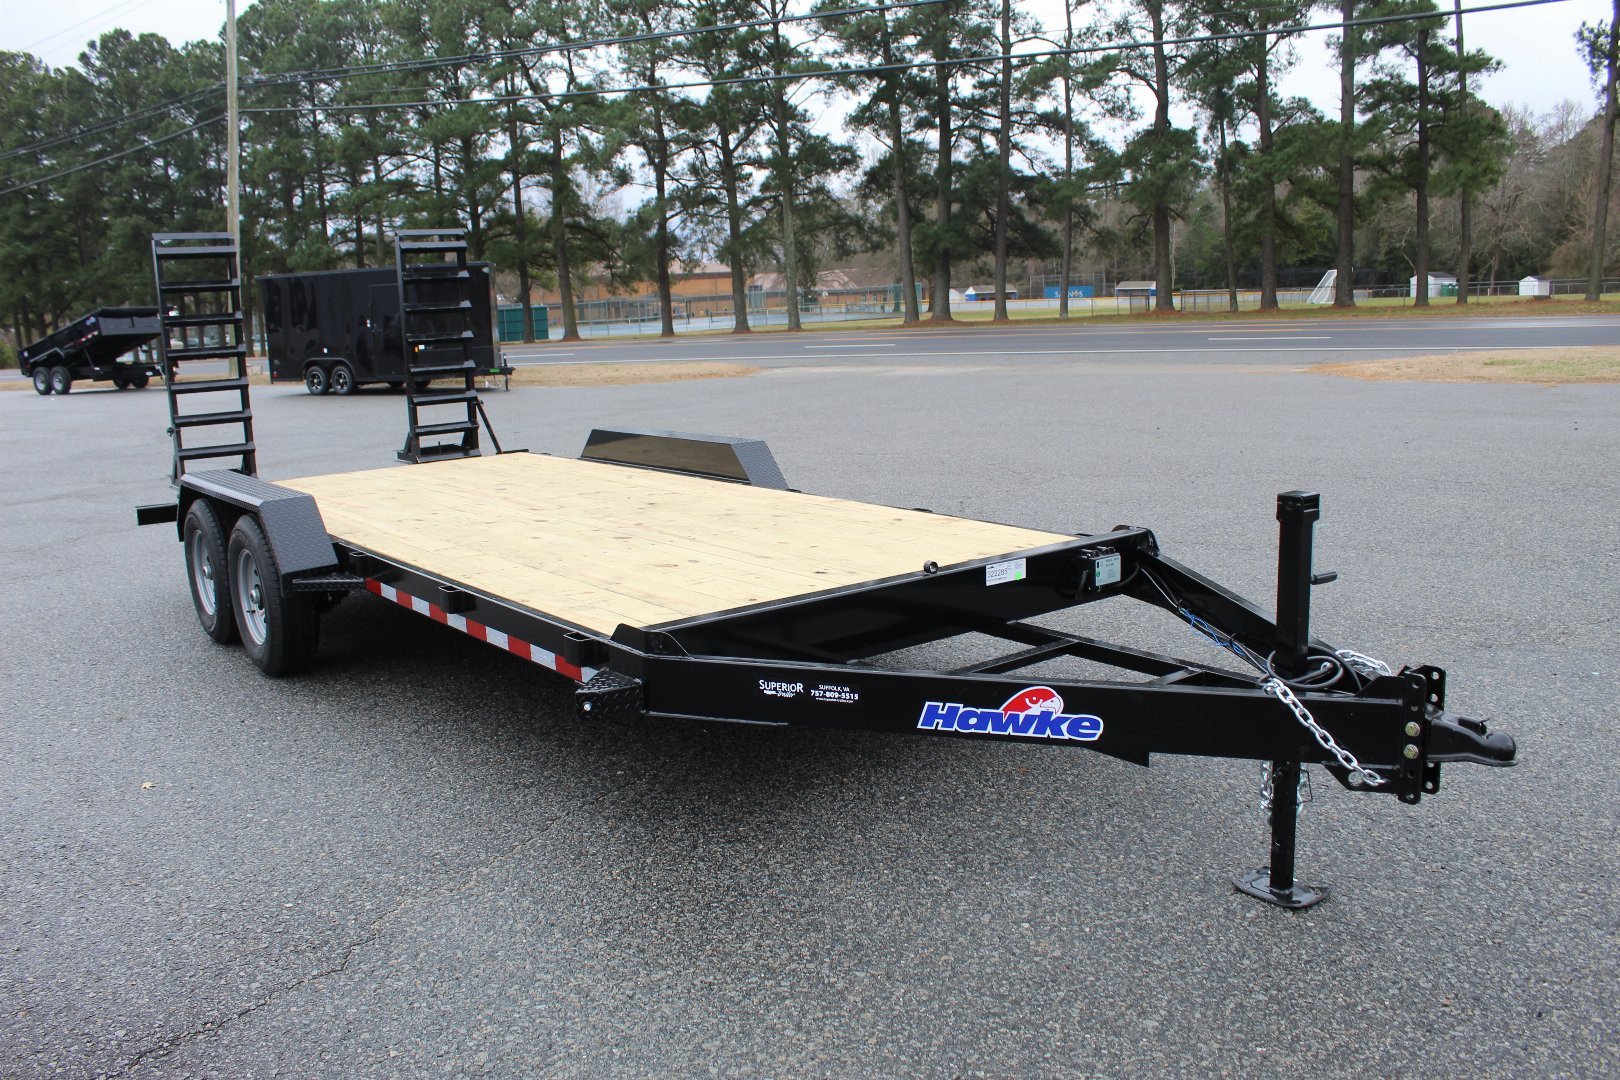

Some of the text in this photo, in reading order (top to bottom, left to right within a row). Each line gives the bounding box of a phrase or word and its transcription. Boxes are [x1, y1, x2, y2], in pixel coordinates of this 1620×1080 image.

[759, 679, 804, 693] SUPERIOR
[818, 684, 843, 692] SUFFOLK,
[810, 689, 859, 700] 757-809-5515
[917, 701, 1104, 741] Hawke
